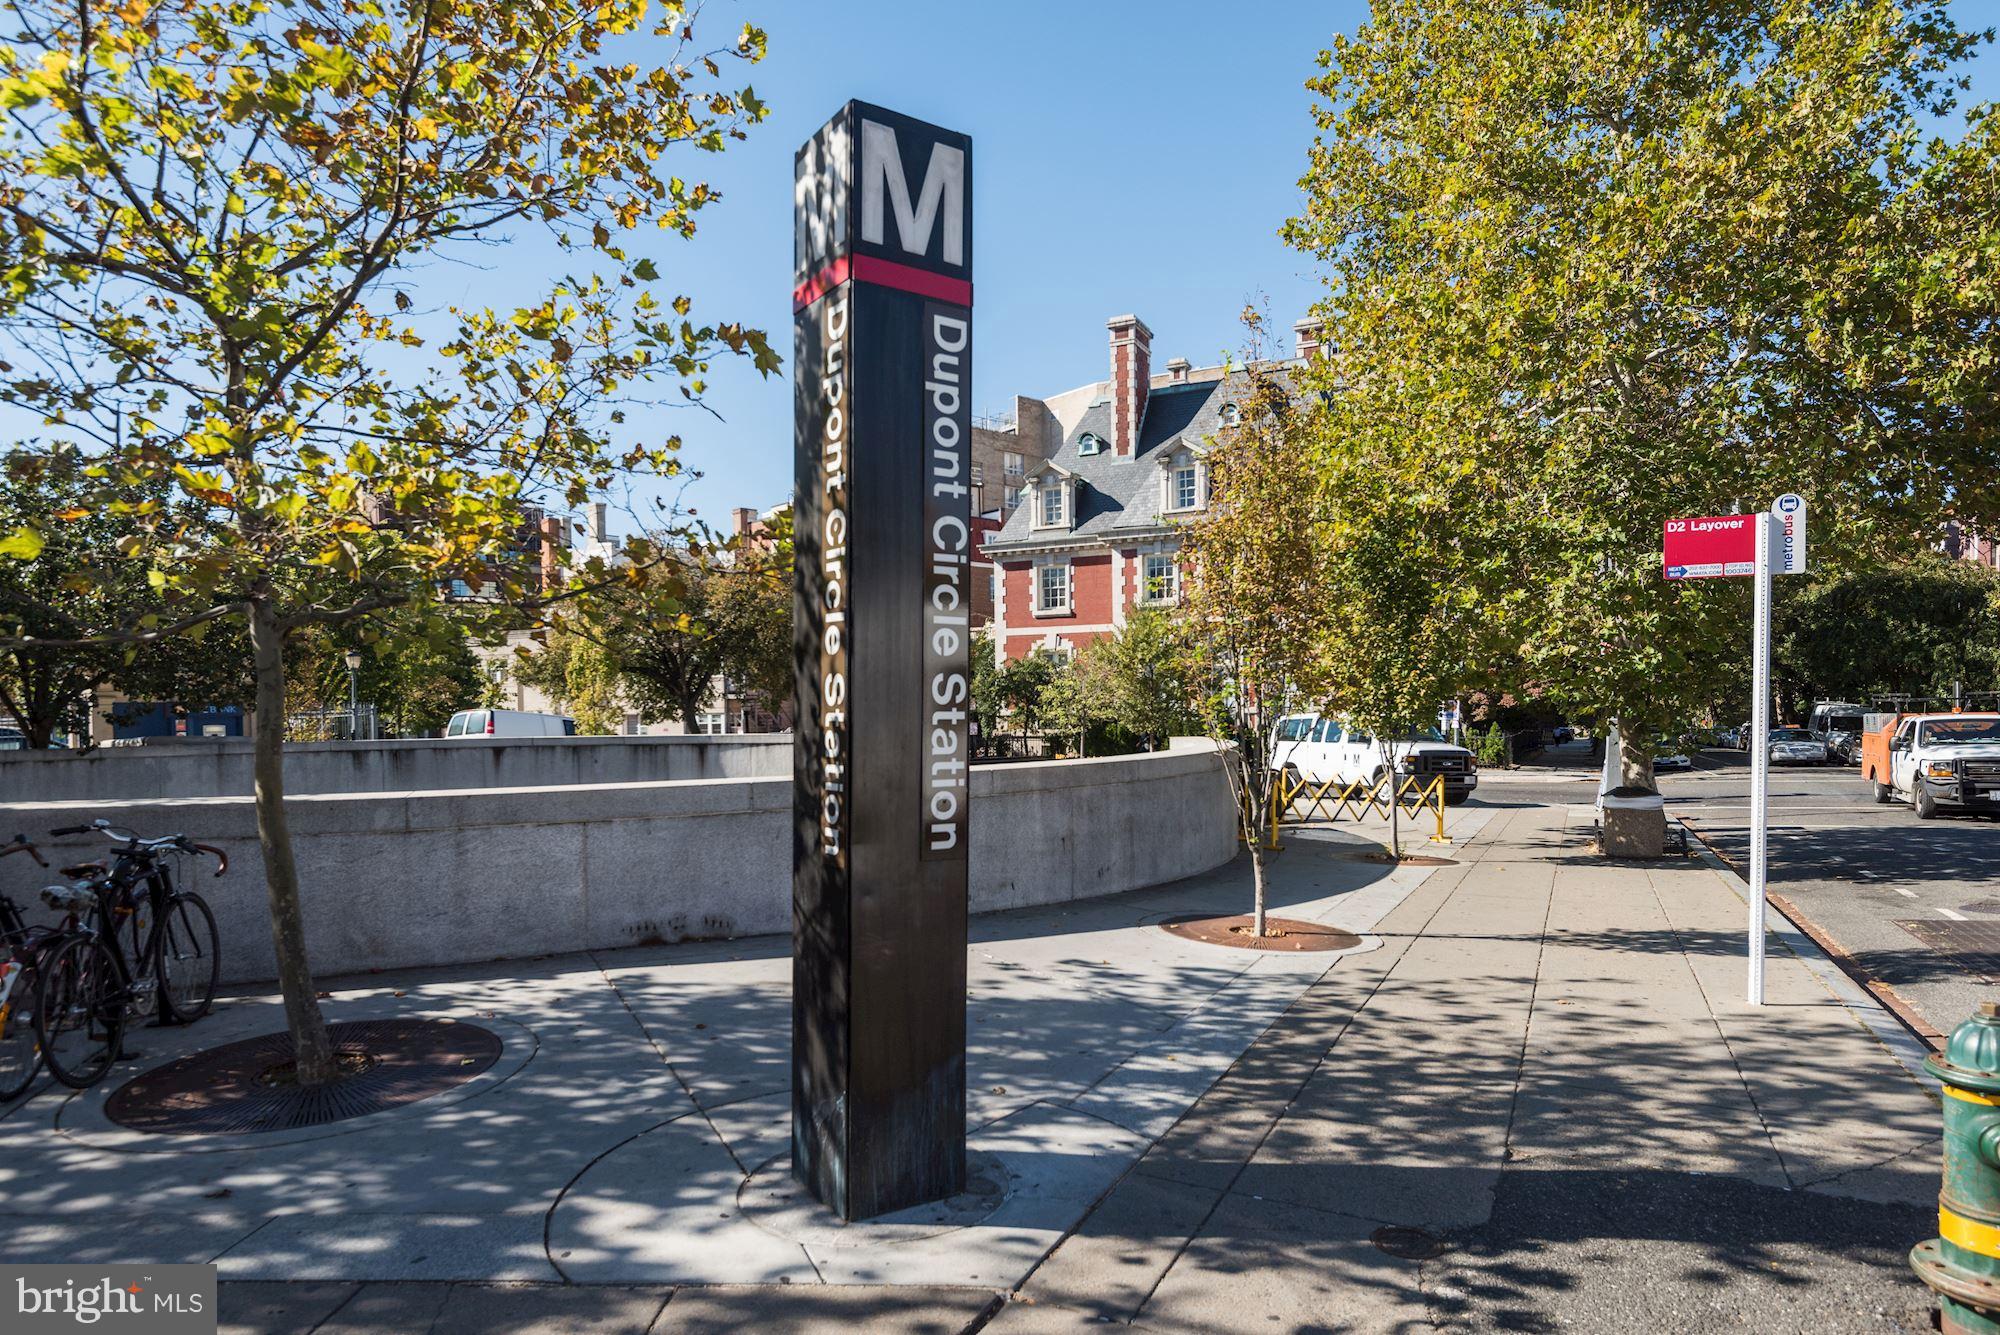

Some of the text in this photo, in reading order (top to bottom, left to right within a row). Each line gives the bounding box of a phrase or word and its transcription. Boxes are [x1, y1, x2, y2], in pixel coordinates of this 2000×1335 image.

[795, 121, 846, 276] M
[861, 118, 964, 267] M
[823, 298, 847, 856] Dupont Circle Station
[925, 314, 967, 851] Dupont Circle Station
[1667, 520, 1744, 533] D2 Layover
[1782, 514, 1793, 571] metrobus
